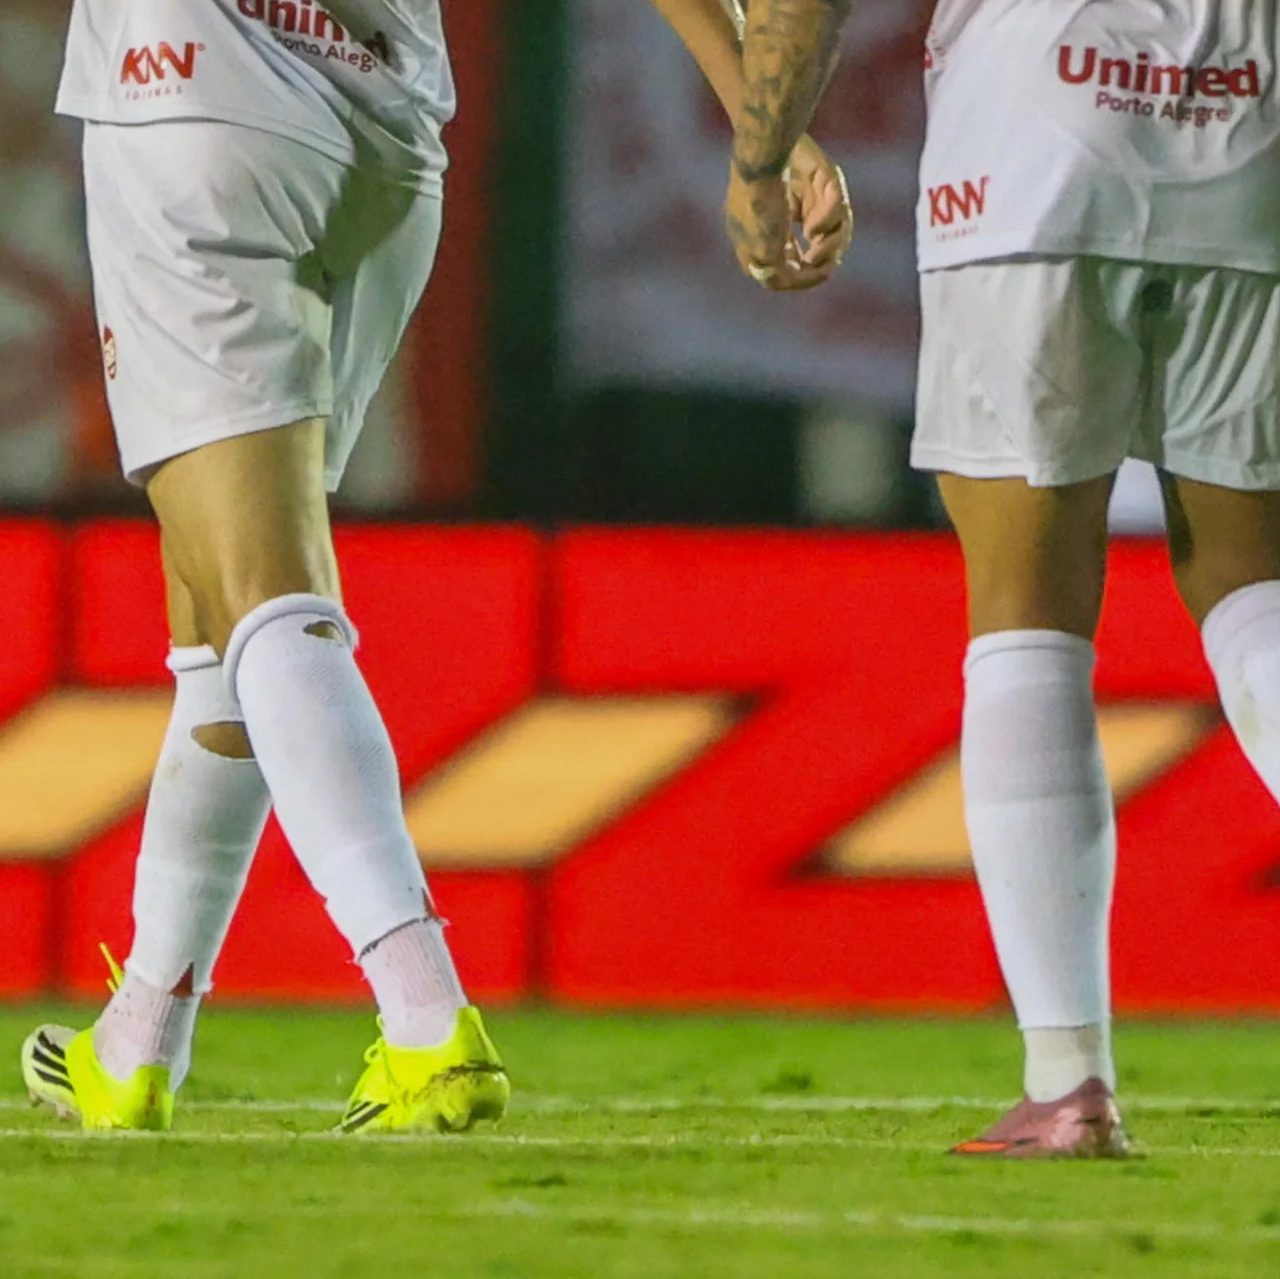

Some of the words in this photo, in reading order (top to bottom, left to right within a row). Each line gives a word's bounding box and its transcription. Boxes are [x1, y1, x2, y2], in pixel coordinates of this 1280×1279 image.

[325, 44, 378, 73] Aleg
[1058, 45, 1260, 98] Unimed
[1096, 92, 1155, 118] Porto
[1161, 101, 1231, 128] Alegre
